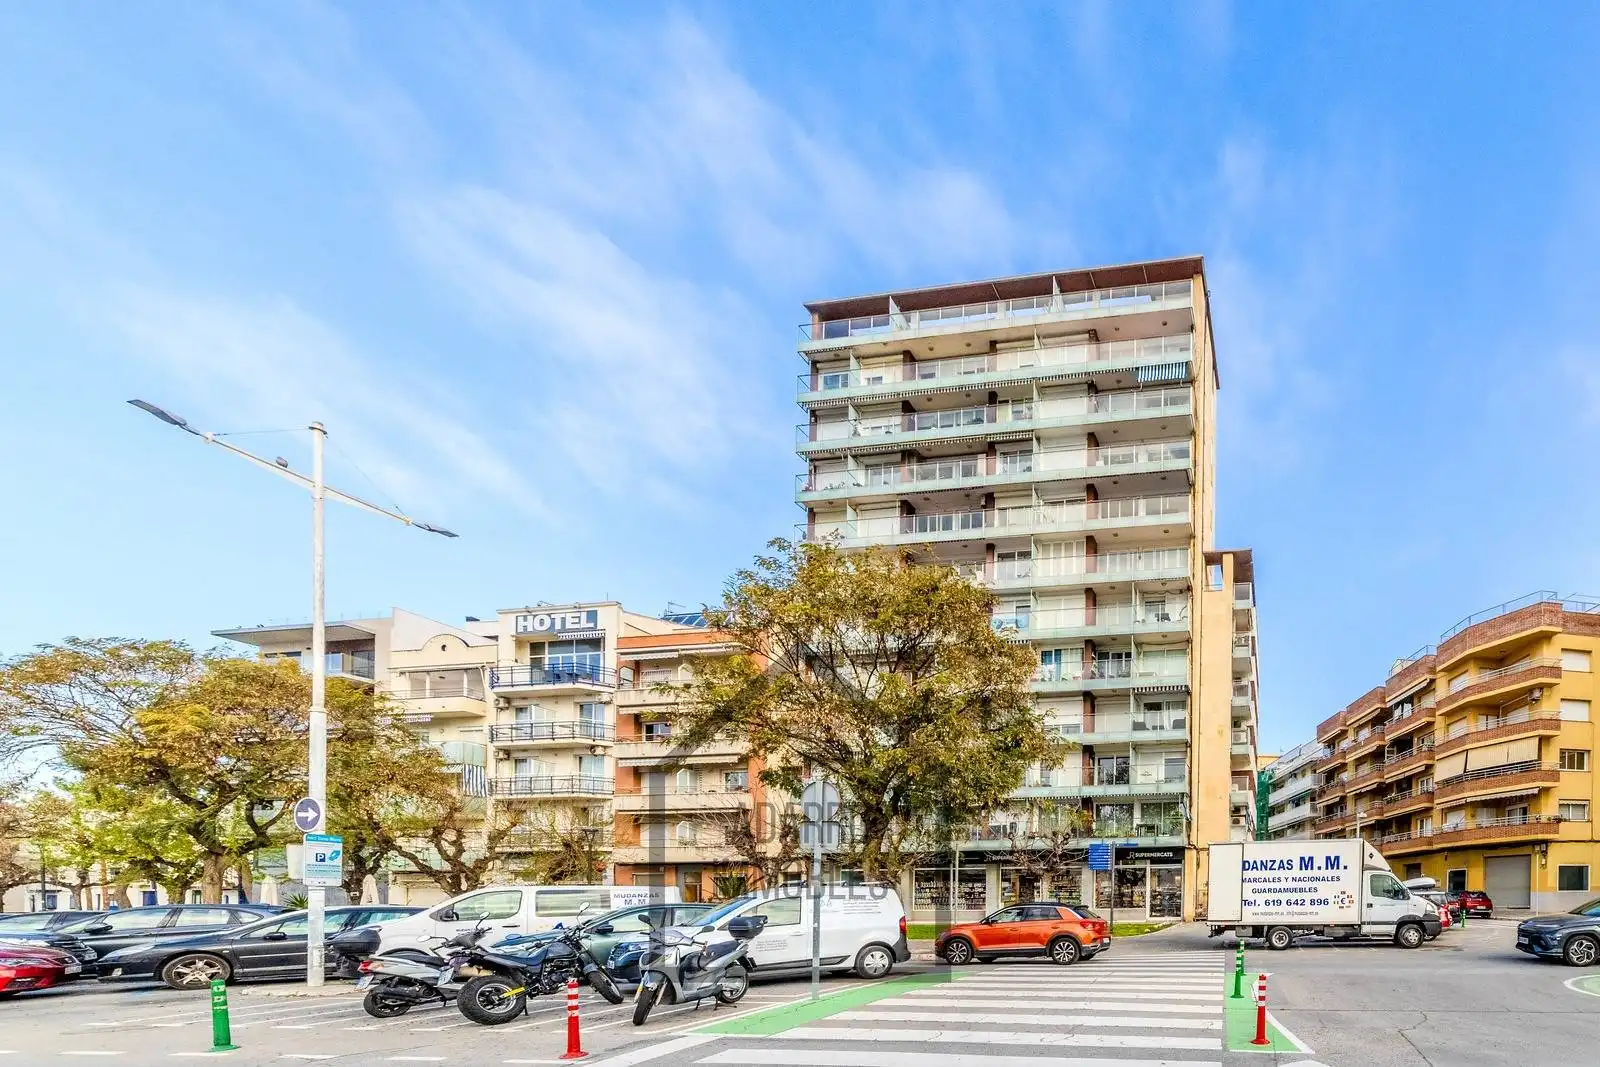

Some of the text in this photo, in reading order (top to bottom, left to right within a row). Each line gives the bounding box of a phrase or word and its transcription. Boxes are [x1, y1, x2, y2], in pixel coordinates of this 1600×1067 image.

[517, 611, 595, 632] HOTEL
[1300, 856, 1348, 870] M.M.
[1309, 898, 1330, 906] 896
